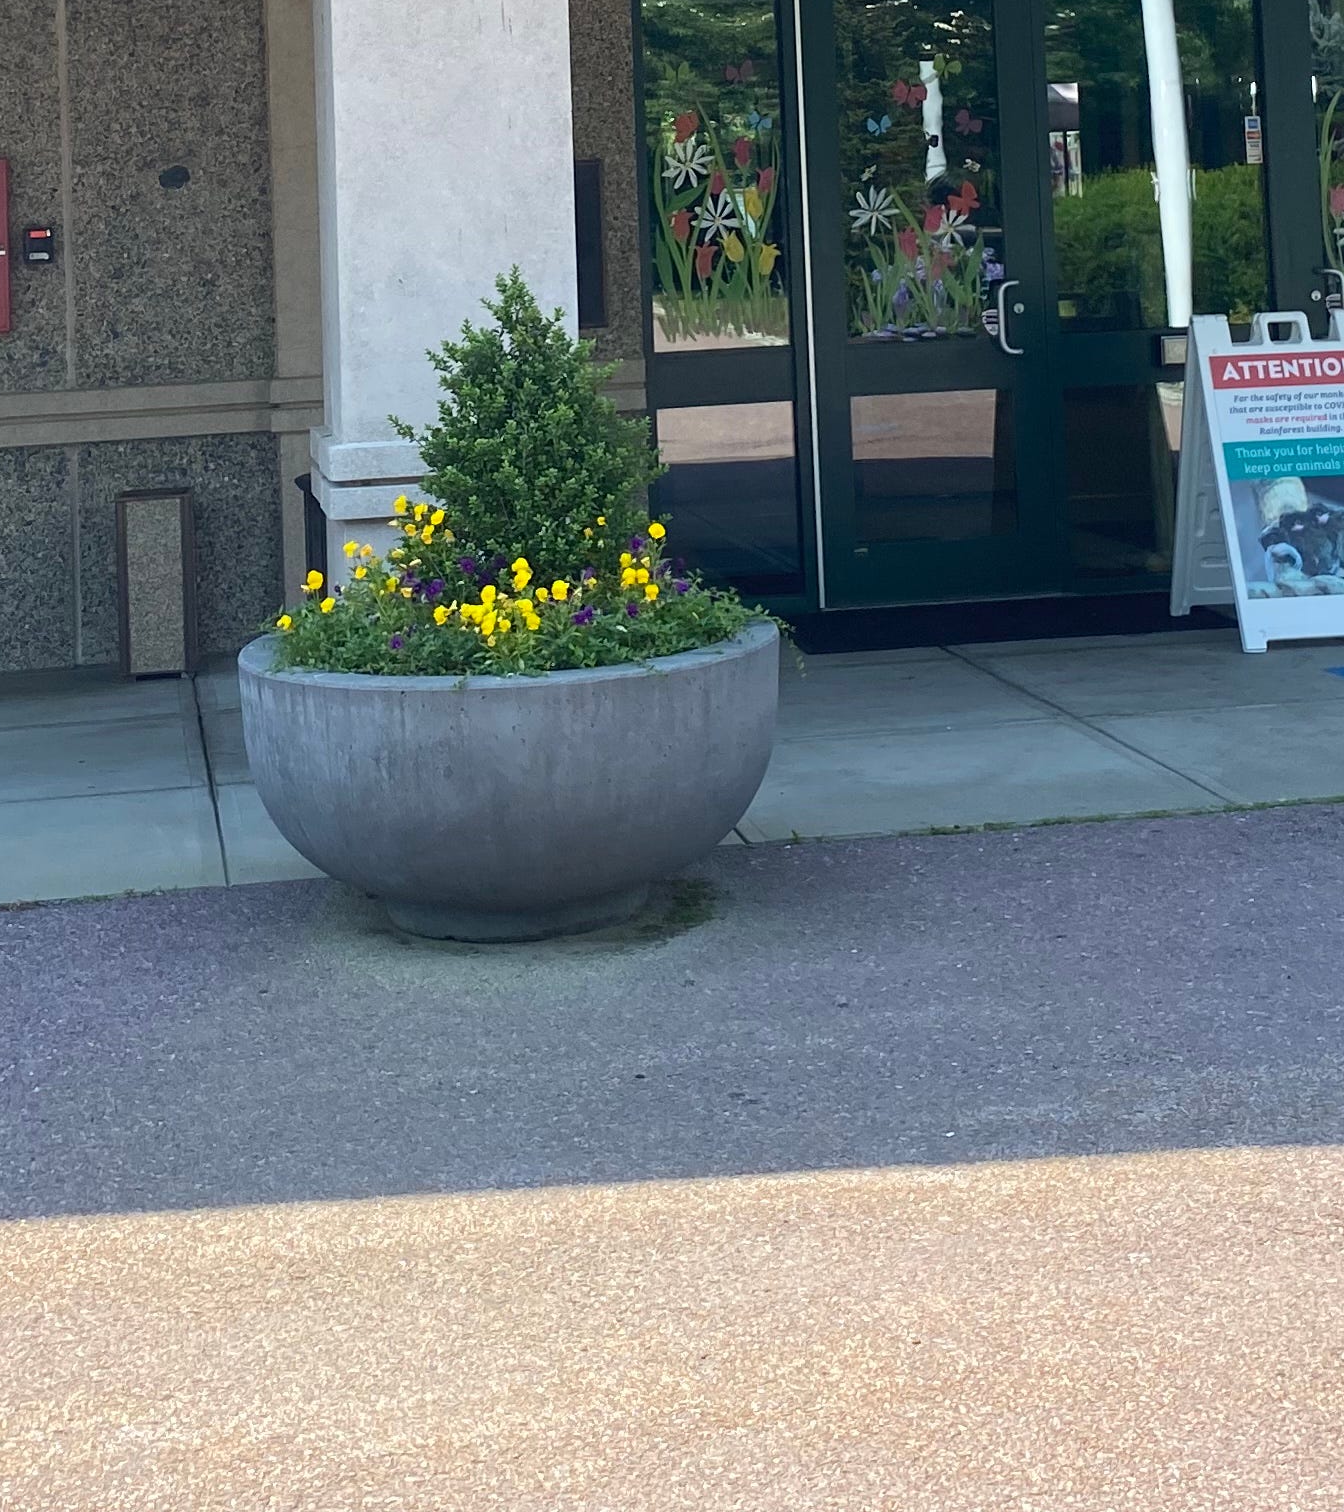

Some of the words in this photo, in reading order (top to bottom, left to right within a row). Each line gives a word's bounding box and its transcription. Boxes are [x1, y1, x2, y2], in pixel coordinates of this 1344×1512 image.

[1234, 395, 1248, 403] For
[1266, 392, 1291, 403] safety
[1294, 393, 1303, 401] of
[1265, 403, 1311, 413] susceptible
[1246, 416, 1273, 424] masks
[1291, 414, 1327, 424] required
[1260, 427, 1304, 436] Rainforest
[1306, 426, 1343, 434] building.
[1235, 446, 1272, 458] Thank
[1274, 448, 1294, 459] you
[1297, 446, 1312, 455] for
[1245, 463, 1270, 475] keep
[1273, 462, 1292, 471] our
[1298, 460, 1340, 470] animals
